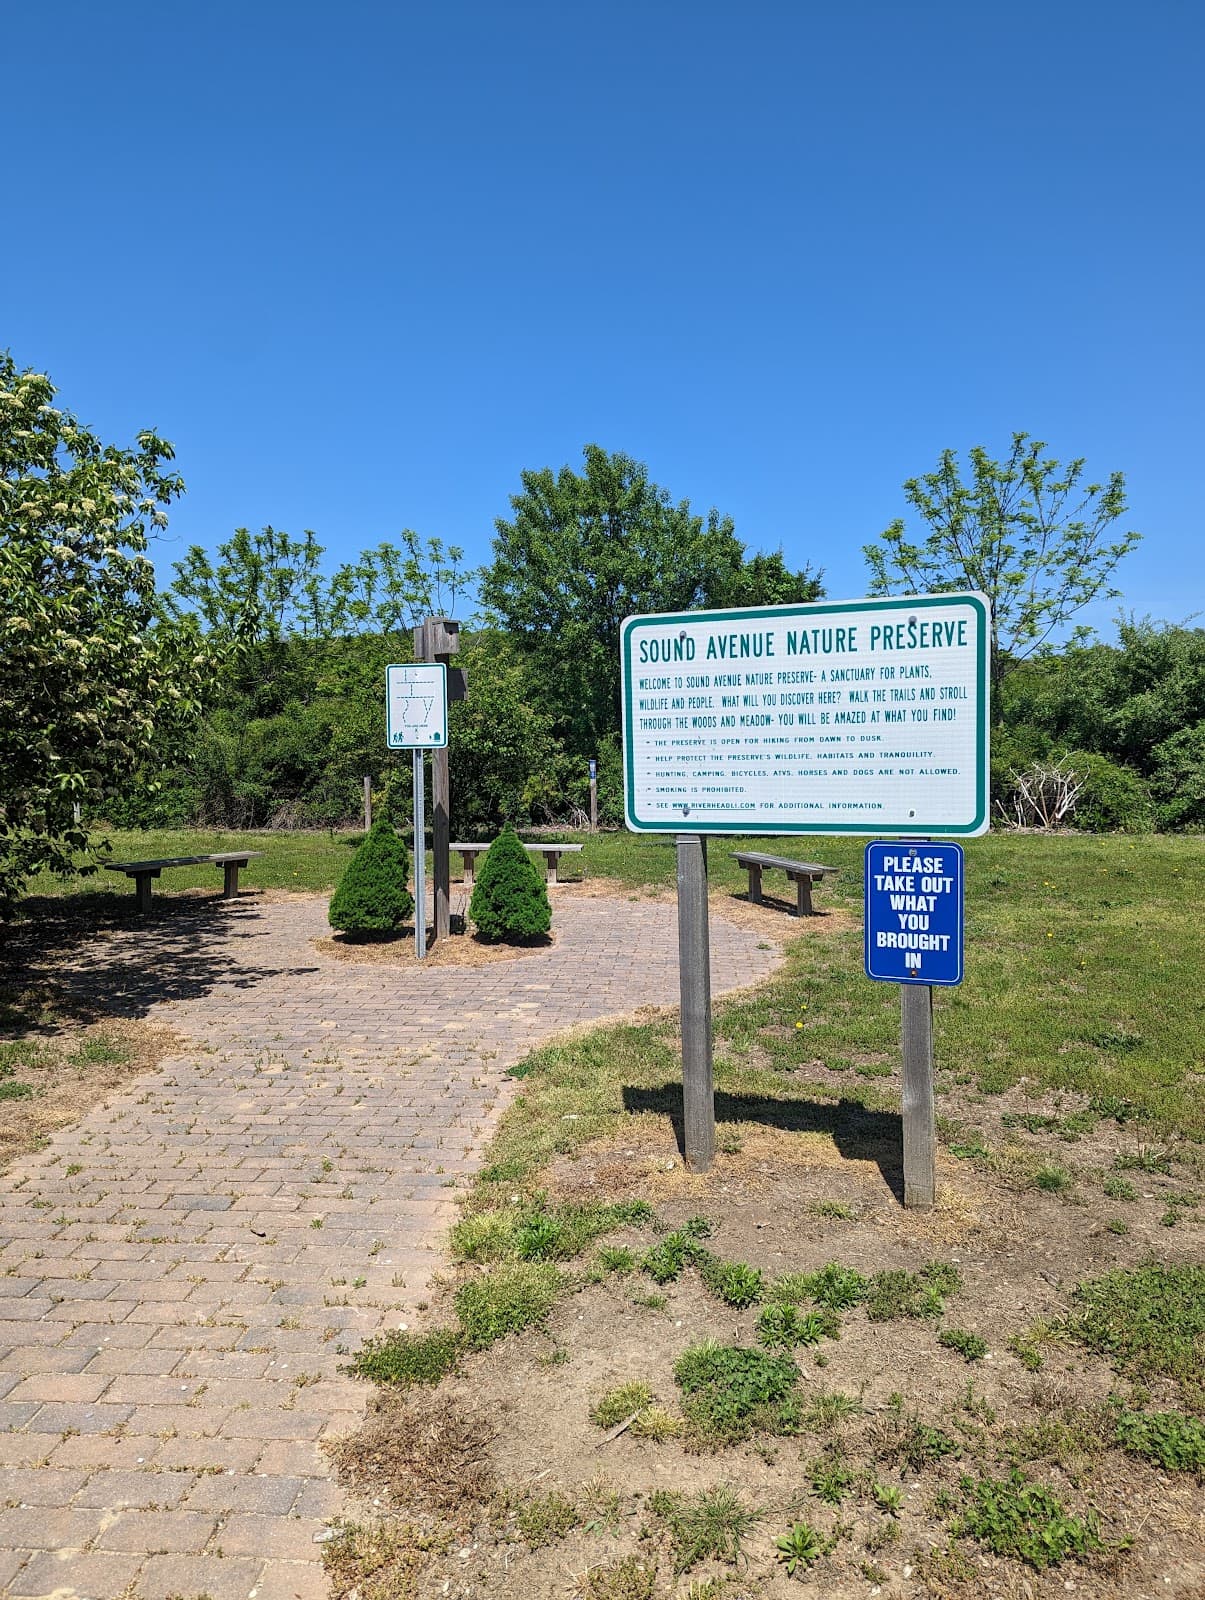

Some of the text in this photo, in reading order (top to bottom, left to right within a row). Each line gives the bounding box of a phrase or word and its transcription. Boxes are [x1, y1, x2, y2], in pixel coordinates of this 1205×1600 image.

[640, 620, 967, 663] SOUND AVENUE NATURE PRESERVE
[640, 678, 670, 690] WELCOME
[675, 678, 682, 688] TO
[687, 676, 710, 688] SOUND
[714, 674, 741, 686] AVENUE
[746, 673, 773, 684] NATURE
[821, 670, 826, 682] A
[831, 668, 874, 681] SANCTUARY
[880, 666, 895, 679] FOR
[640, 686, 967, 710] WILDLIFE AND PEOPLE. WHAT WILL YOU DISCOVER HERE? WALK THE TRAILS AND STROLL
[640, 718, 671, 730] THROUGH
[676, 717, 688, 728] THE
[692, 716, 716, 728] WOODS
[721, 716, 735, 727] AND
[779, 714, 793, 725] YOU
[798, 713, 816, 725] WILL
[821, 713, 830, 724] BE
[835, 712, 866, 723] AMAZED
[871, 711, 880, 723] AT
[885, 710, 906, 722] WHAT
[912, 709, 928, 721] YOU
[934, 708, 956, 720] FIND!
[884, 857, 943, 873] PLEASE
[875, 875, 953, 893] TAKE OUT
[890, 895, 937, 911] WHAT
[899, 914, 929, 930] YOU
[877, 932, 950, 951] BROUGHT
[905, 953, 921, 968] IN
